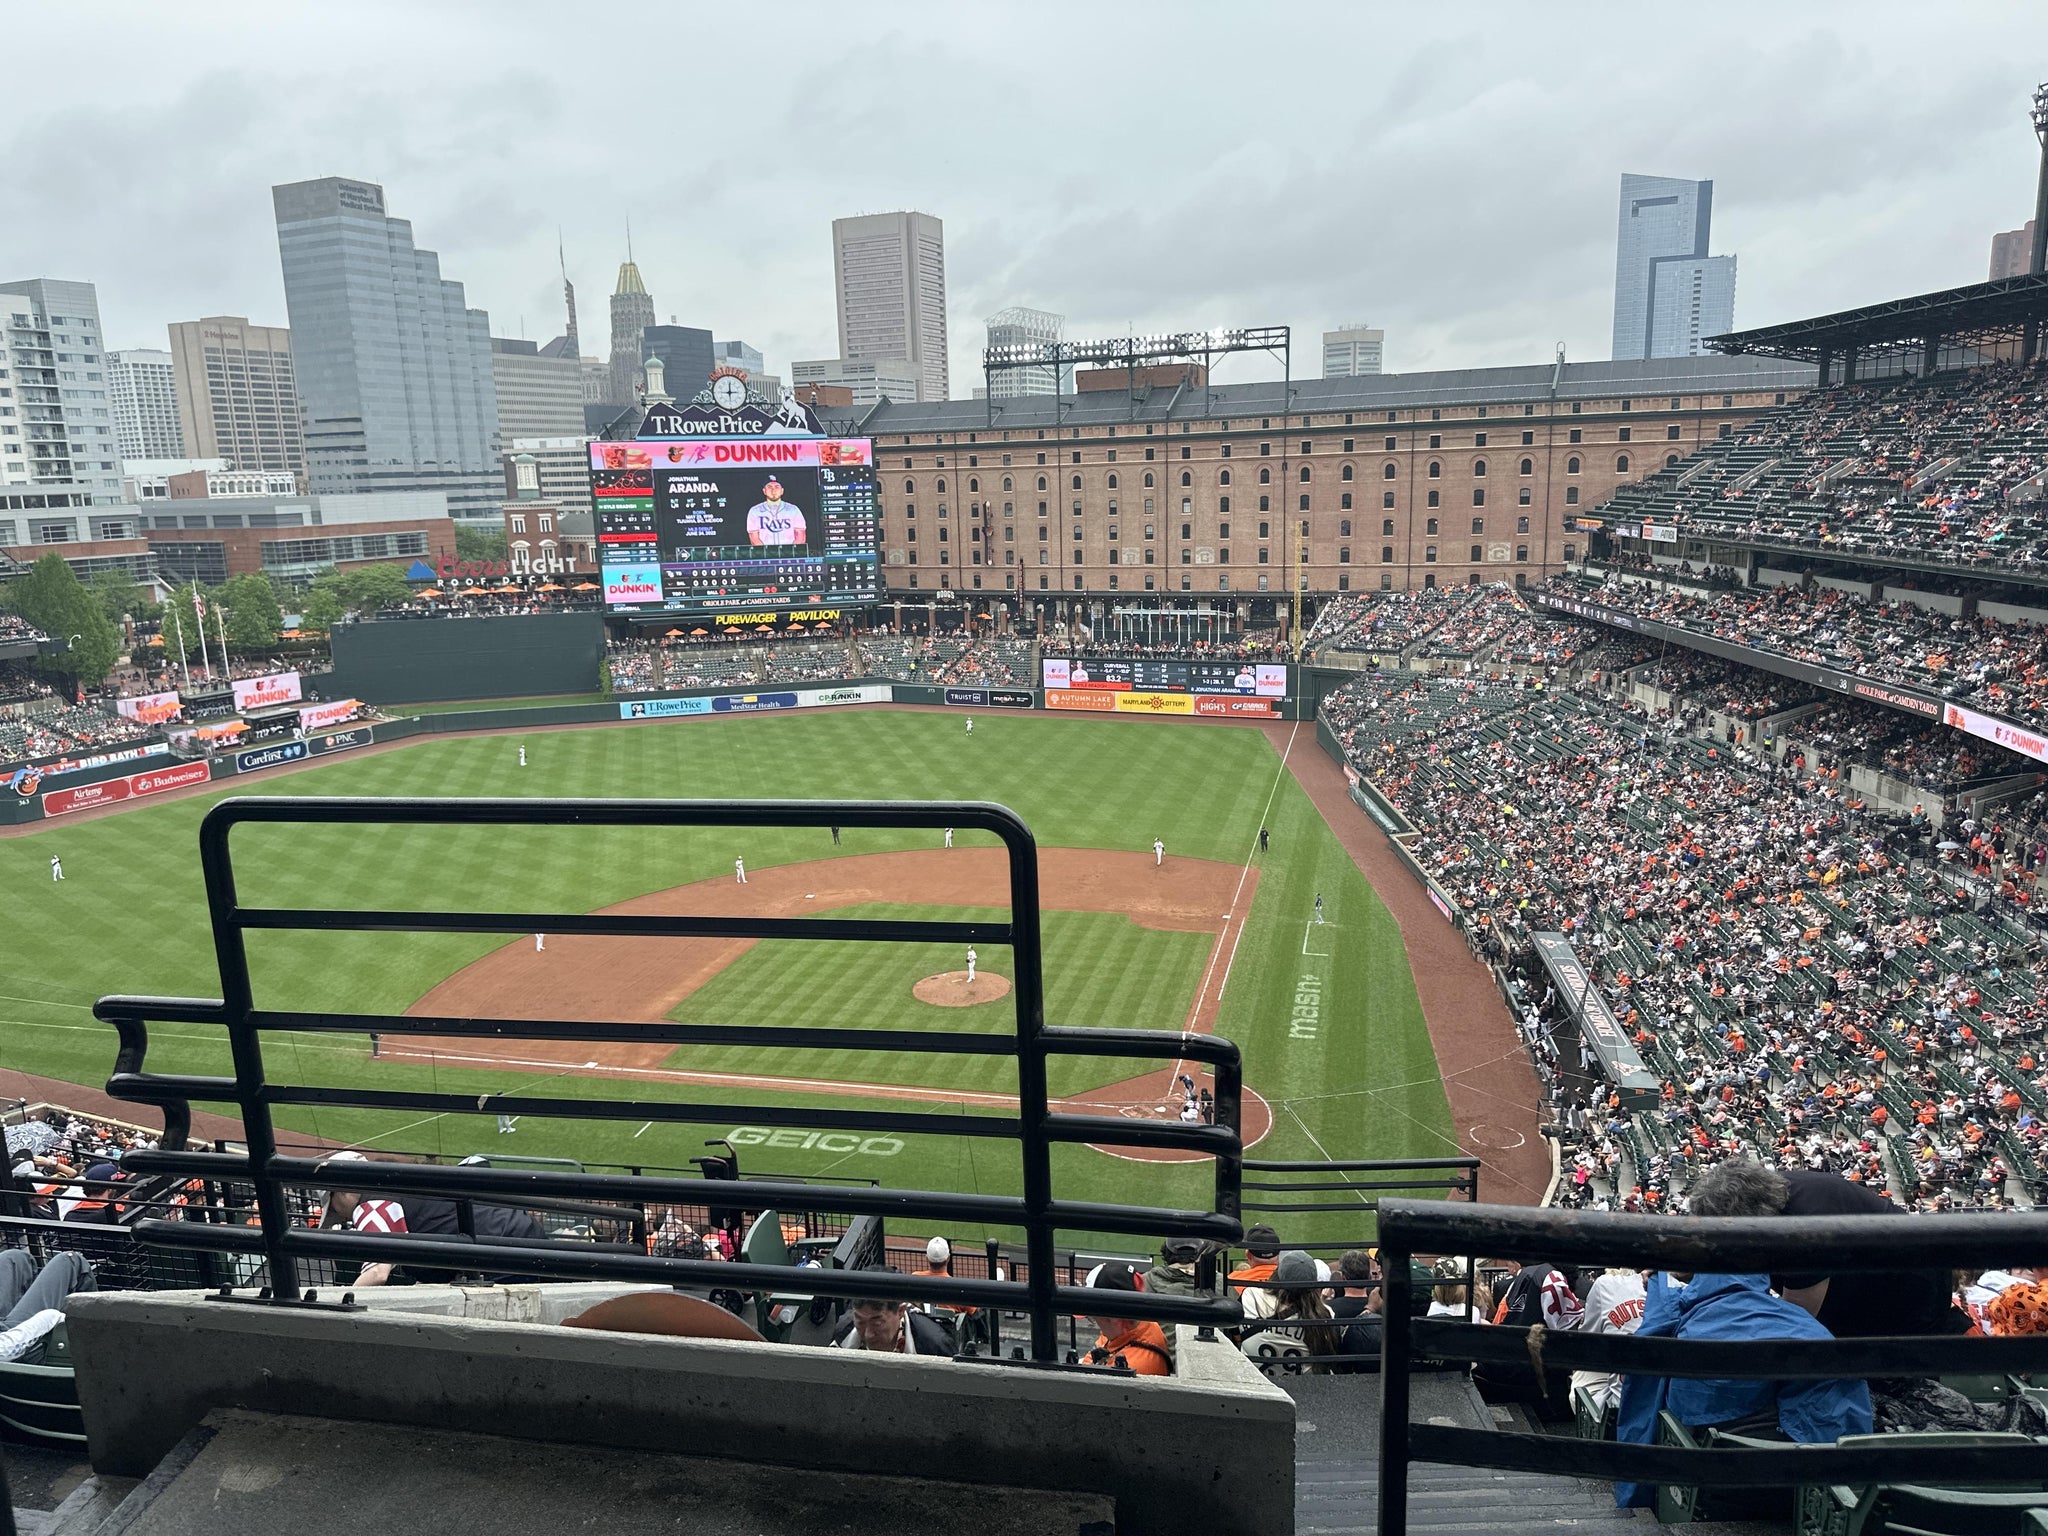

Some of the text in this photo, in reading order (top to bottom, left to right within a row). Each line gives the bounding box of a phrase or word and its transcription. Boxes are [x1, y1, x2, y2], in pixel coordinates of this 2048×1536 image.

[714, 443, 802, 463] DUNKIN'
[669, 483, 719, 493] ARANDA
[436, 552, 577, 578] Coors LIGHT
[437, 574, 550, 587] ROOF DECK
[609, 584, 657, 594] DUNKIN'
[715, 610, 841, 625] PUREWAGER PAVILION
[1839, 678, 1847, 690] 38
[244, 688, 291, 706] DUNKIN'
[831, 692, 861, 701] RANKIN
[1855, 683, 1875, 698] ORIOLE
[1875, 689, 1889, 701] PARK
[1894, 694, 1919, 710] CAMDEN
[1919, 702, 1938, 716] YARDS
[730, 700, 780, 710] MedStar Health
[1200, 703, 1226, 712] HIGH'S
[335, 732, 355, 744] PNC
[2011, 732, 2045, 756] DUNKIN'
[79, 755, 108, 769] BIRD
[108, 750, 138, 763] BATH
[244, 749, 283, 767] CareFirst
[153, 770, 204, 787] Budweiser
[73, 786, 103, 799] Airtemp
[726, 1126, 905, 1156] GEICO
